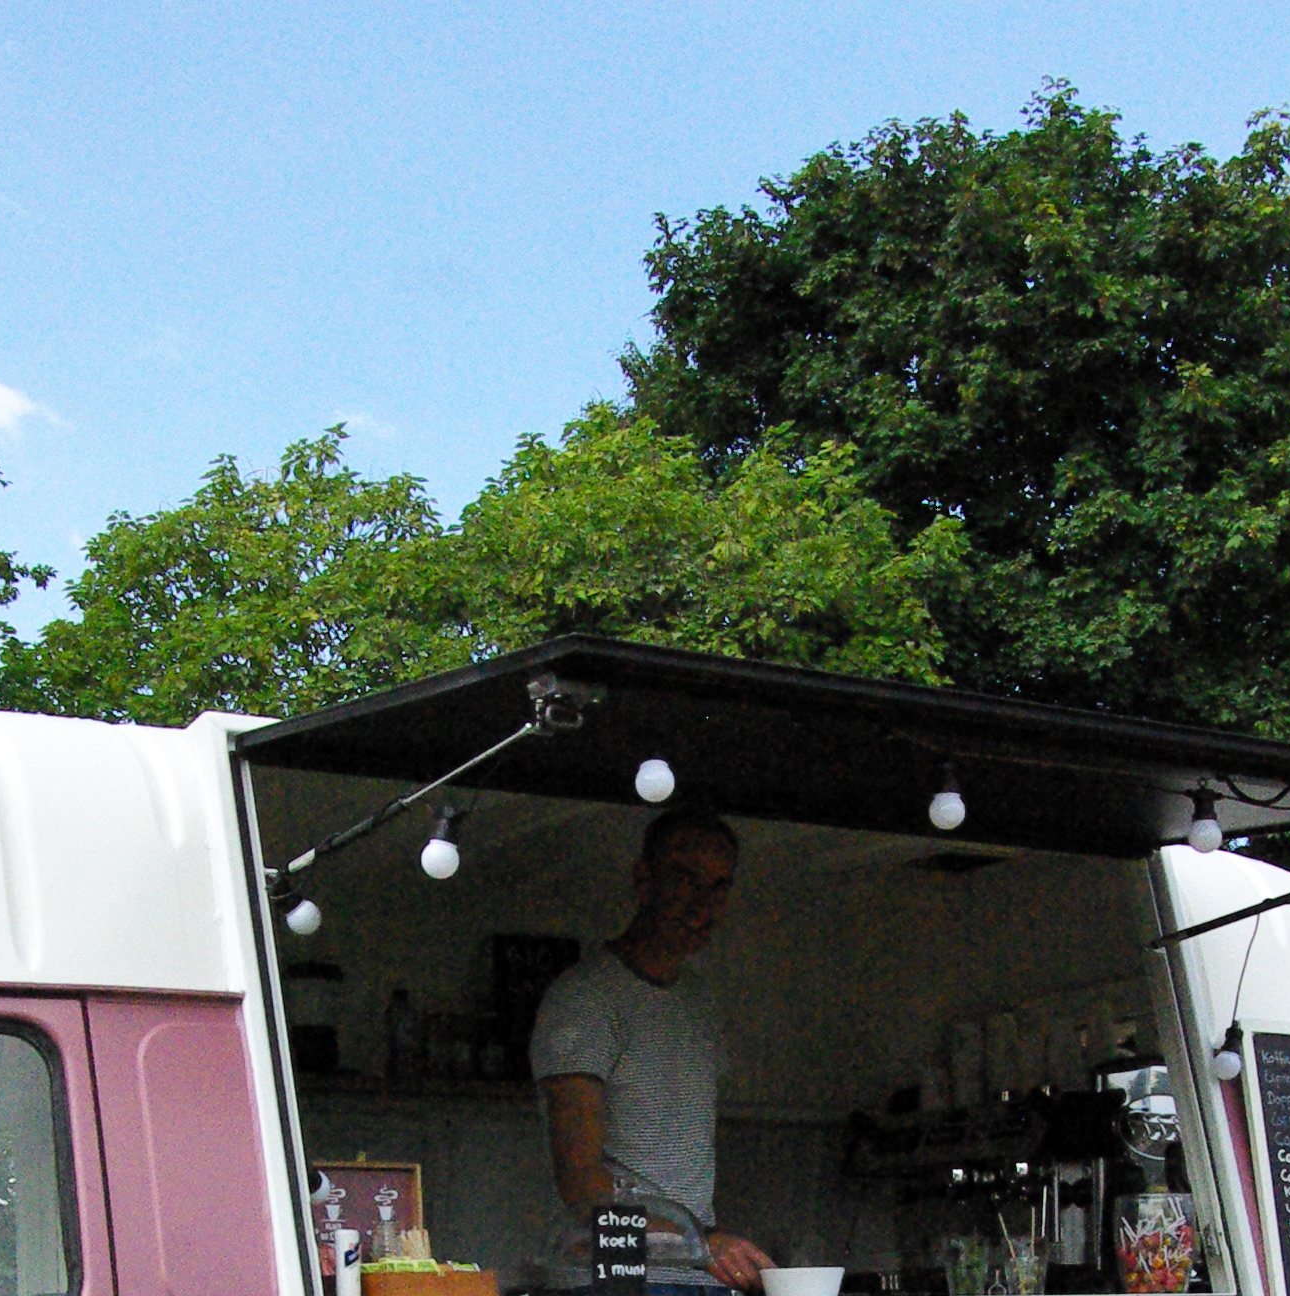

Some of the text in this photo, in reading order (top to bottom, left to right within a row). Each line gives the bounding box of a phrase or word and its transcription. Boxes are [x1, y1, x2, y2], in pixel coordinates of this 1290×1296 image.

[598, 1210, 647, 1228] choco
[599, 1233, 638, 1249] koek
[597, 1263, 646, 1279] 1 munt
